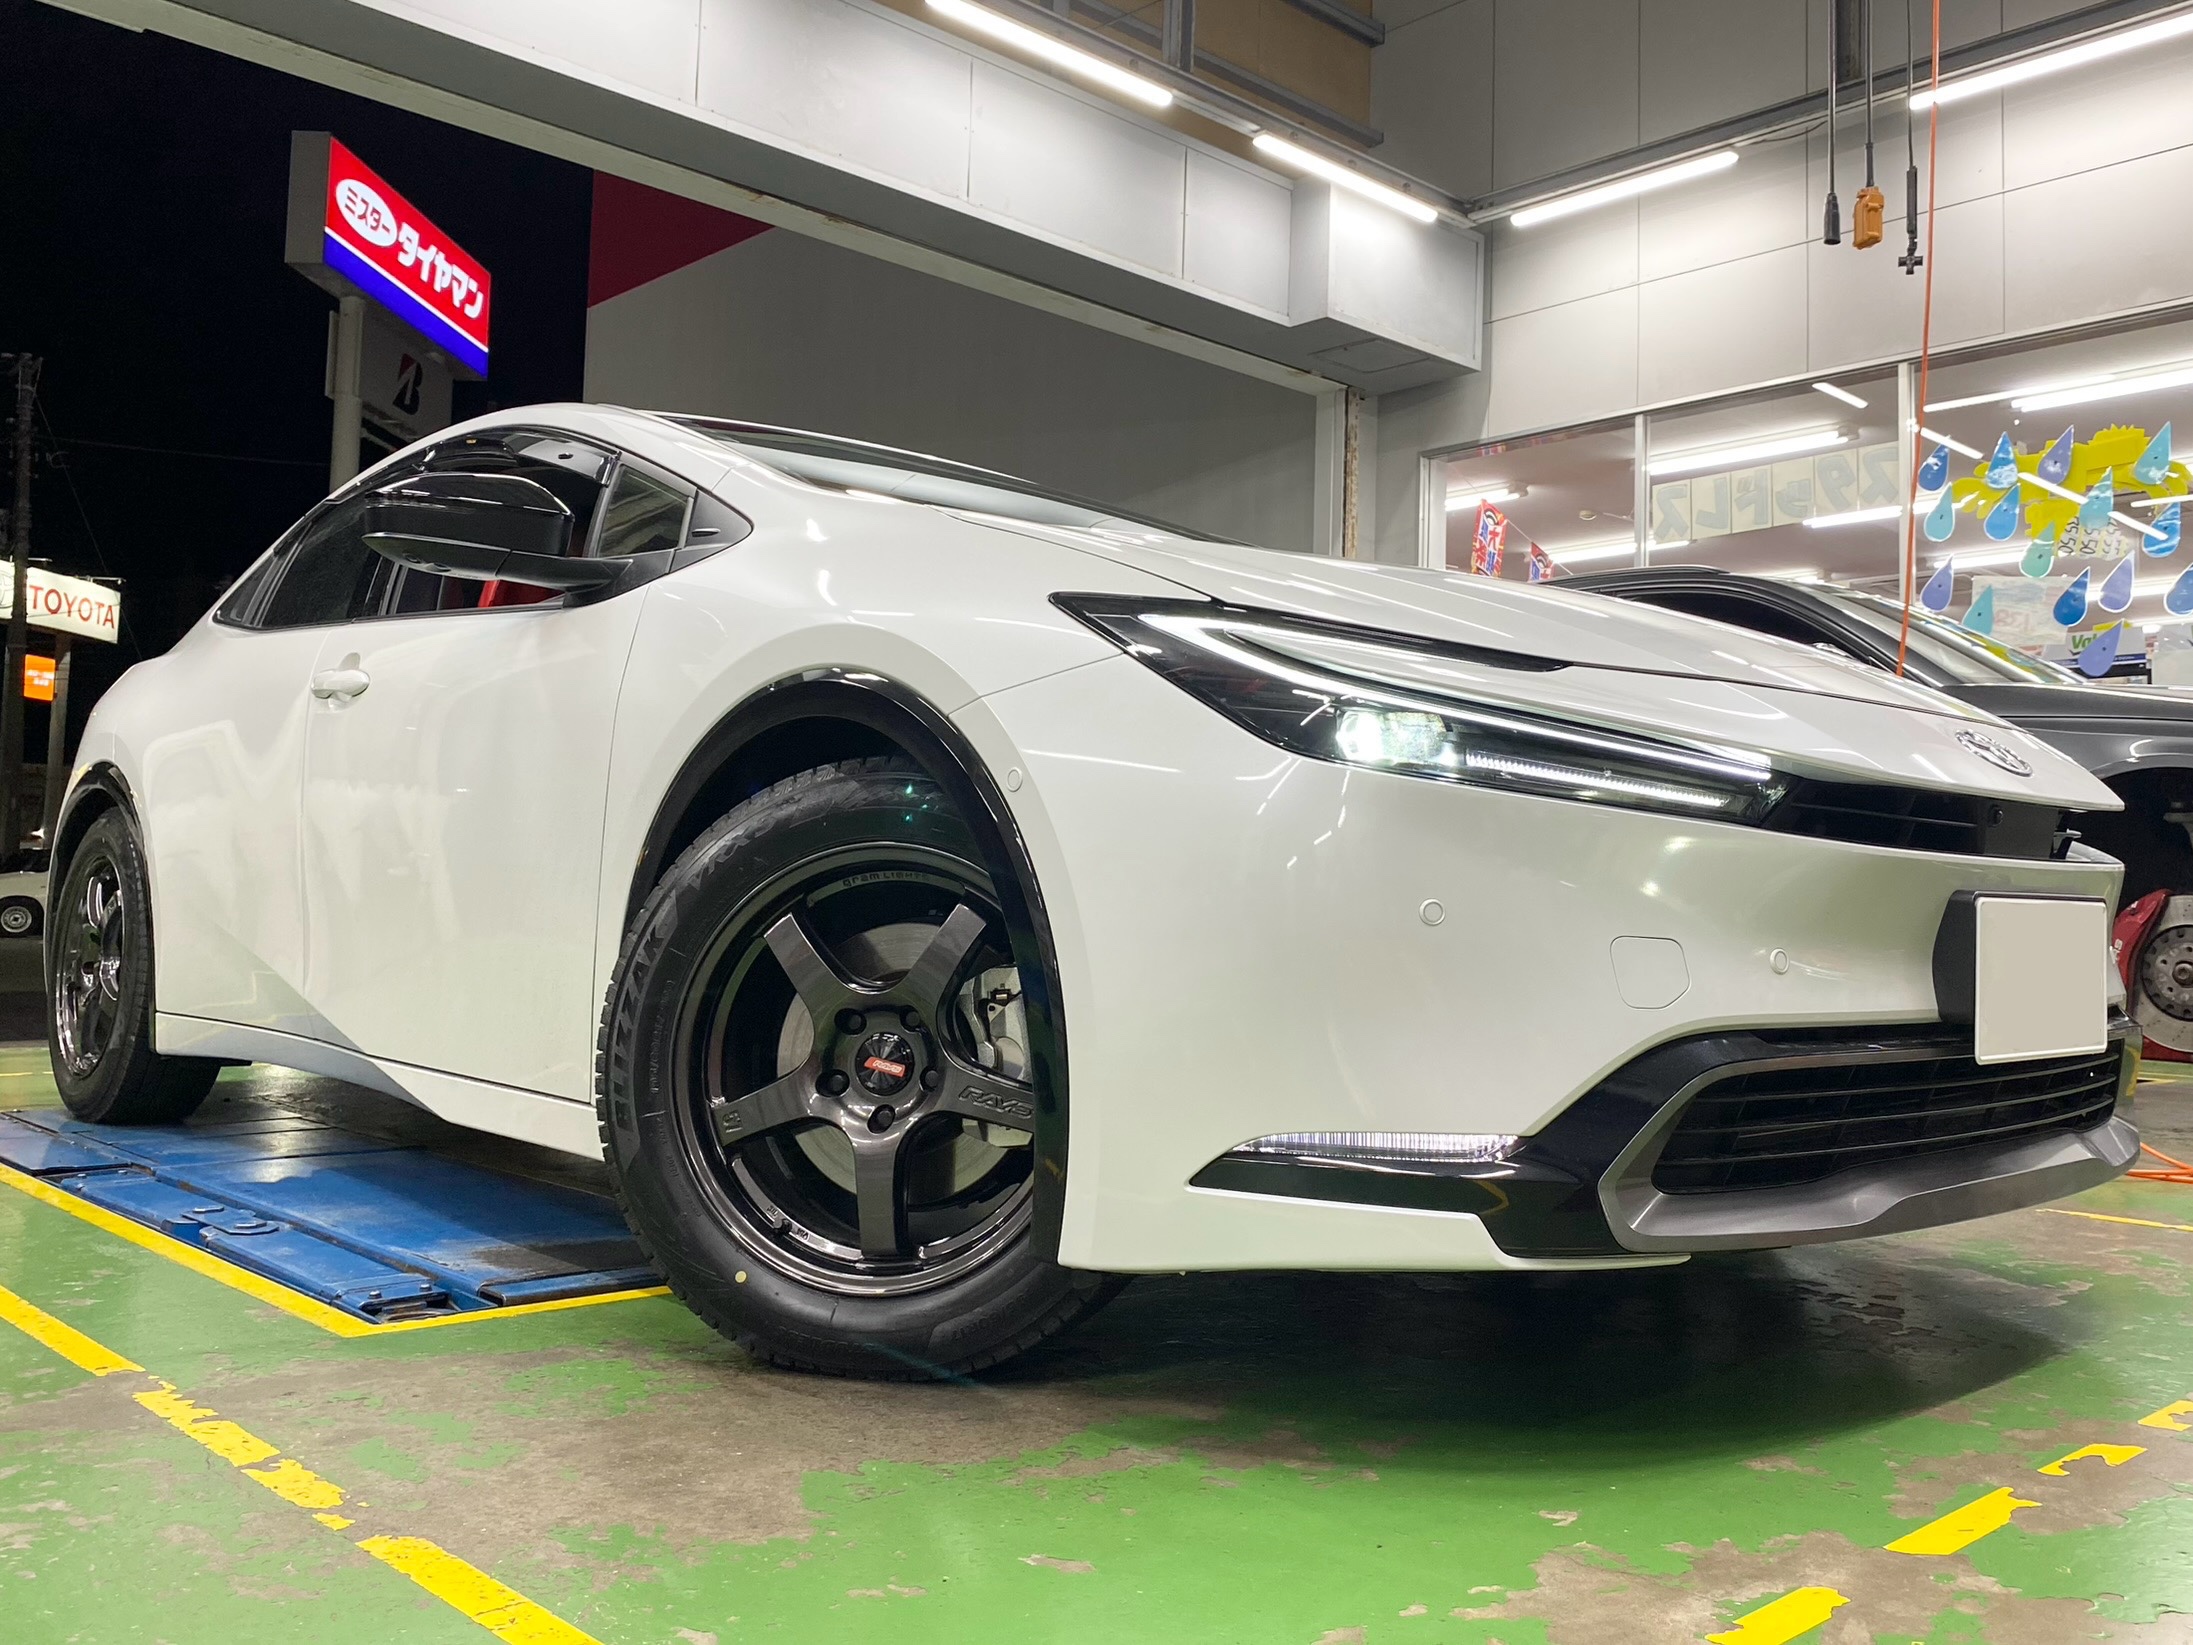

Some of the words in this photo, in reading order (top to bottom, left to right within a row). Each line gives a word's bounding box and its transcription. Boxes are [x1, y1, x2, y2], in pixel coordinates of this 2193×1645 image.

[344, 186, 392, 235] ミスター
[397, 222, 484, 319] タイヤマン
[29, 585, 115, 629] TOYOTA
[842, 873, 880, 887] gram
[614, 924, 666, 1133] BLIZZAK
[872, 1060, 903, 1074] RAYS
[958, 1085, 1034, 1120] RAYS
